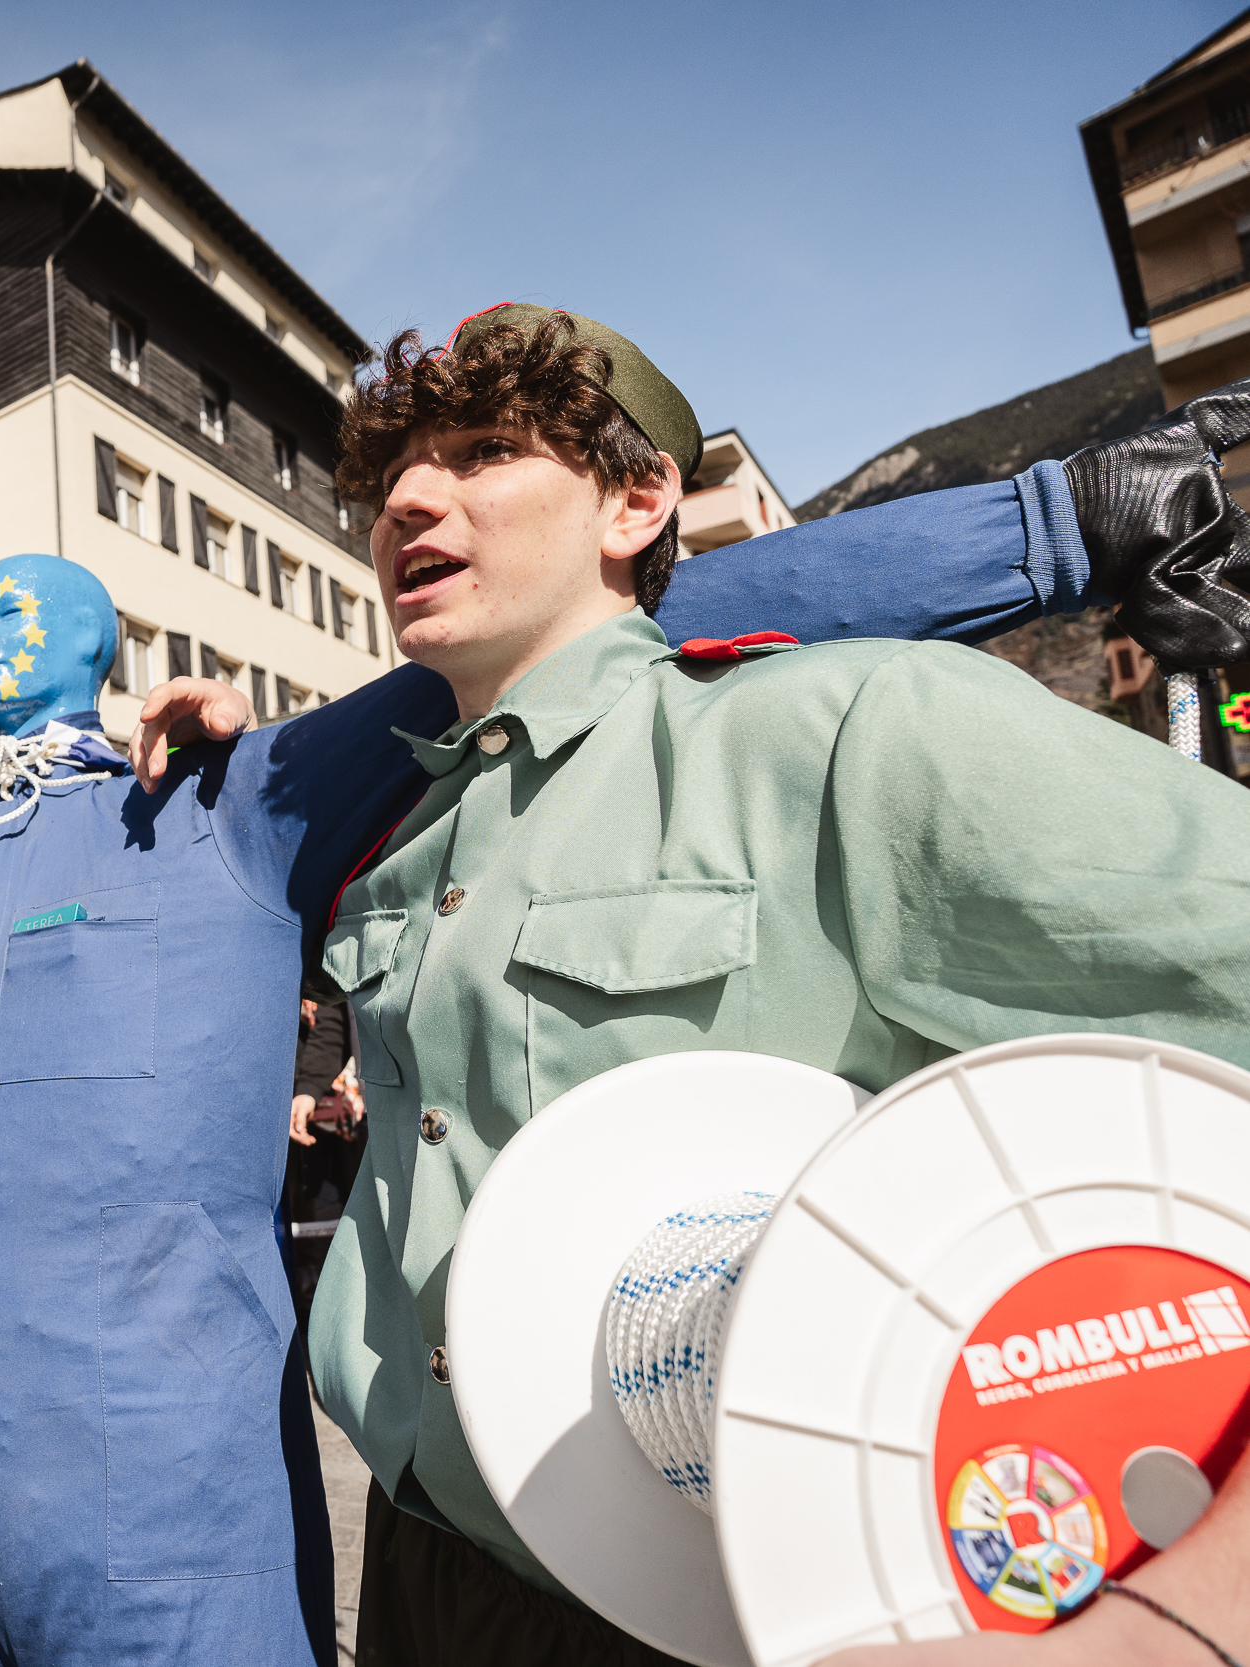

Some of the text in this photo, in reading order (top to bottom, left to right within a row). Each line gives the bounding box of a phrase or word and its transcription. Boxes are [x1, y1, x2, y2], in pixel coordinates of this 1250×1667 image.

[25, 913, 63, 931] TEREA
[961, 1300, 1196, 1390] ROMBULL
[1125, 1357, 1139, 1372] Y
[1140, 1343, 1204, 1370] MALLAS
[1006, 1512, 1046, 1549] R
